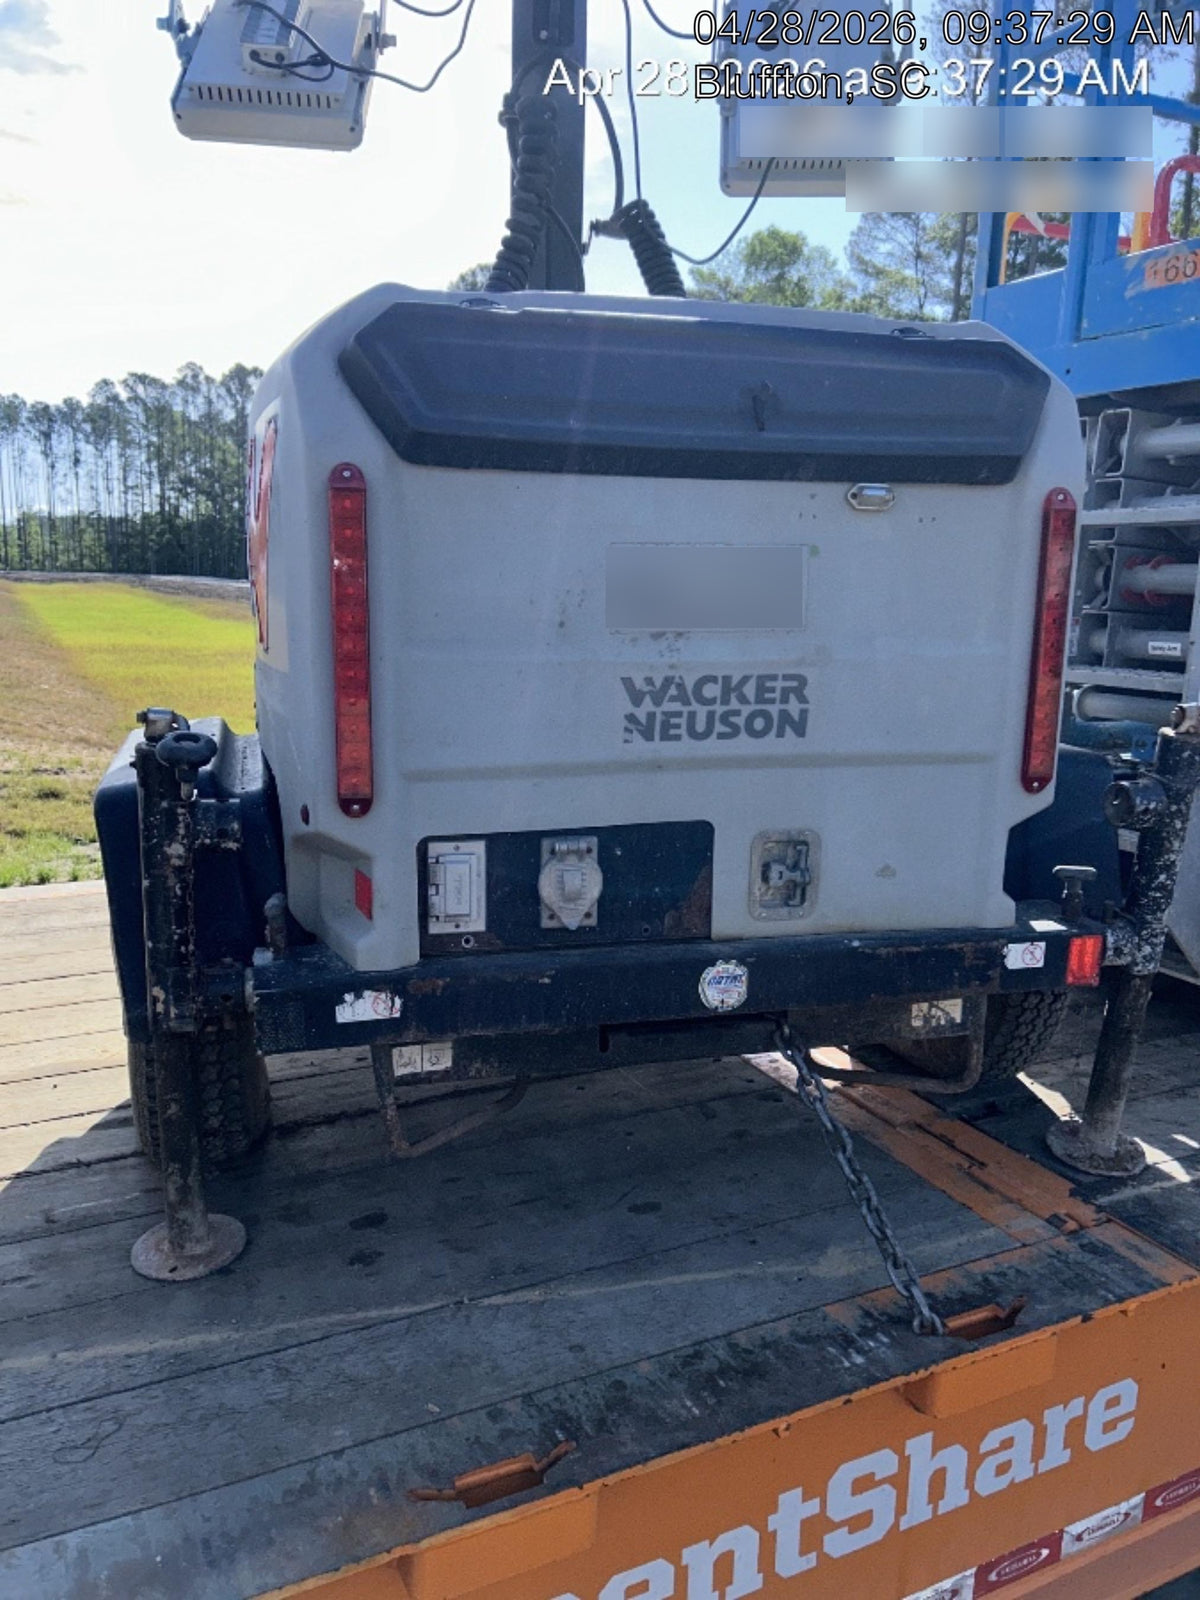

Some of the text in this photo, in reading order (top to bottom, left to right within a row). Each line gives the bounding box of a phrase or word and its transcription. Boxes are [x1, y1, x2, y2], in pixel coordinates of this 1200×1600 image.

[619, 673, 811, 709] WACKER
[622, 707, 811, 744] NEUSON
[548, 1376, 1139, 1600] entShare
